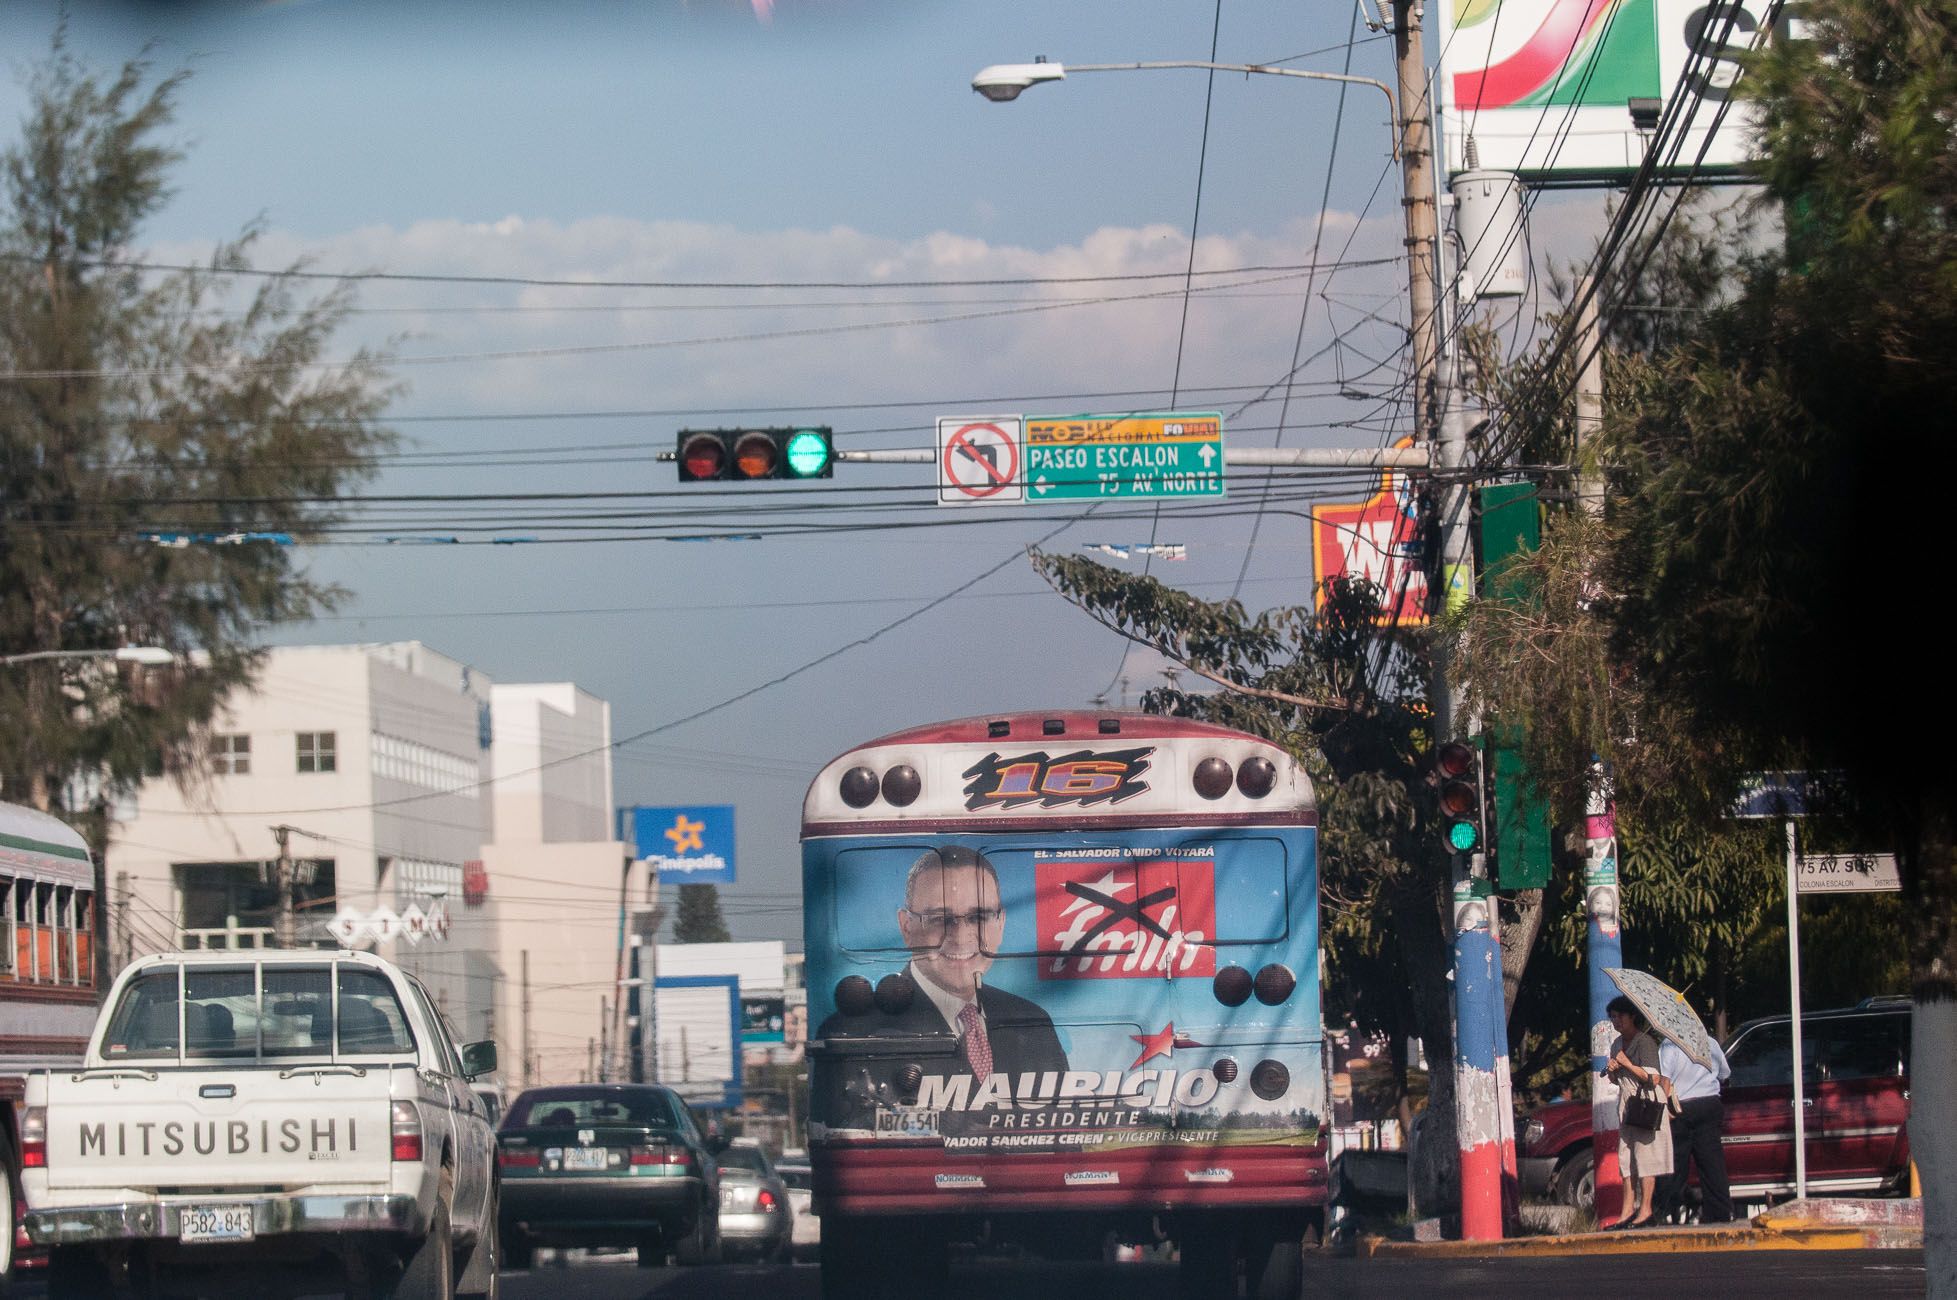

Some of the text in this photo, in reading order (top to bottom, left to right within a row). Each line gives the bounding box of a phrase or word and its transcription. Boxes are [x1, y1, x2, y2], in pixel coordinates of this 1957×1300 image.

[1031, 446, 1179, 469] PASEO ESCALON
[1098, 472, 1120, 494] 75
[1163, 471, 1219, 492] NORTE
[985, 760, 1129, 799] 16
[1055, 848, 1120, 859] SALVADOR
[1124, 847, 1161, 858] UNIDO
[1165, 845, 1215, 858] VOTARÁ
[1800, 861, 1815, 875] 75
[1818, 861, 1841, 874] AV.
[1050, 904, 1204, 973] fmln
[916, 1069, 1221, 1113] MAURICIO
[988, 1110, 1140, 1130] PRESIDENTE
[79, 1117, 357, 1157] MITSUBISHI
[990, 1134, 1056, 1147] SANCHEZ
[1058, 1133, 1104, 1145] CEREN
[1118, 1130, 1220, 1144] VICEPRESIDENTE
